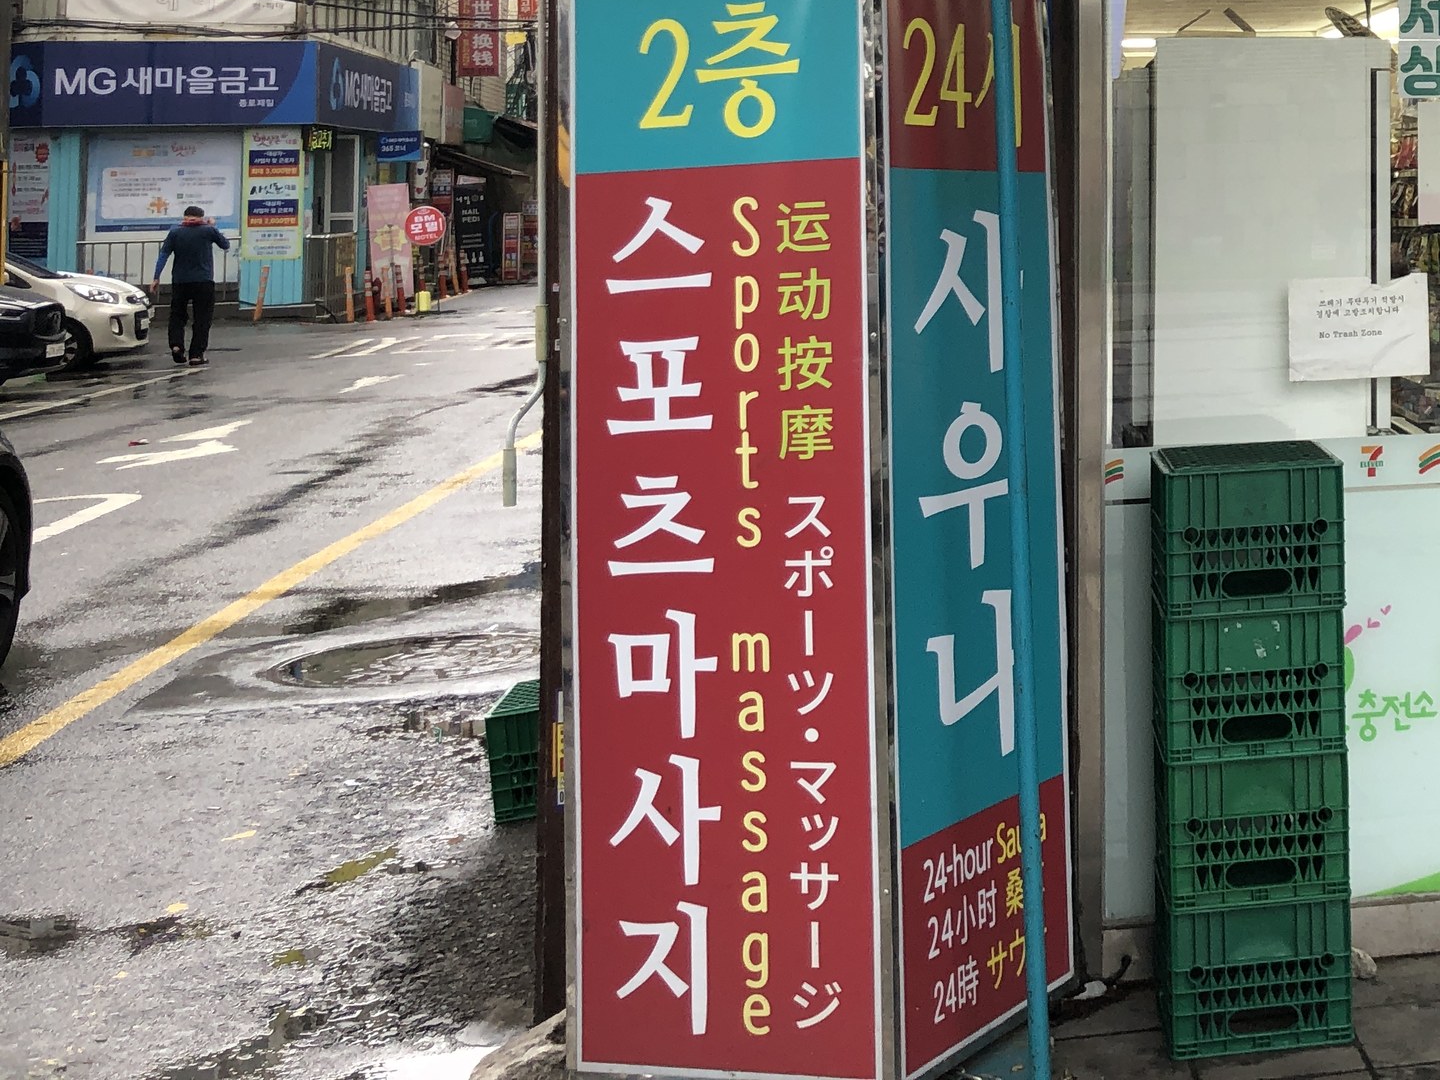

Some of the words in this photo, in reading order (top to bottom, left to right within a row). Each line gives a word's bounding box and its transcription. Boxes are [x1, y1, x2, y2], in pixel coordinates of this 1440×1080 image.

[54, 67, 117, 96] MG
[121, 65, 280, 96] 새마을금고
[344, 69, 360, 109] MG
[360, 72, 393, 114] 새마을금고
[637, 0, 800, 139] 2층
[732, 196, 764, 548] Sports
[776, 200, 834, 461] 运动按摩
[1333, 330, 1359, 338] Trash
[1361, 329, 1383, 337] Zone
[605, 196, 722, 1036] 스포츠마사지
[731, 631, 772, 1036] massage
[923, 837, 994, 904] 24-hour
[996, 812, 1047, 865] Saua
[933, 954, 980, 1025] 24時
